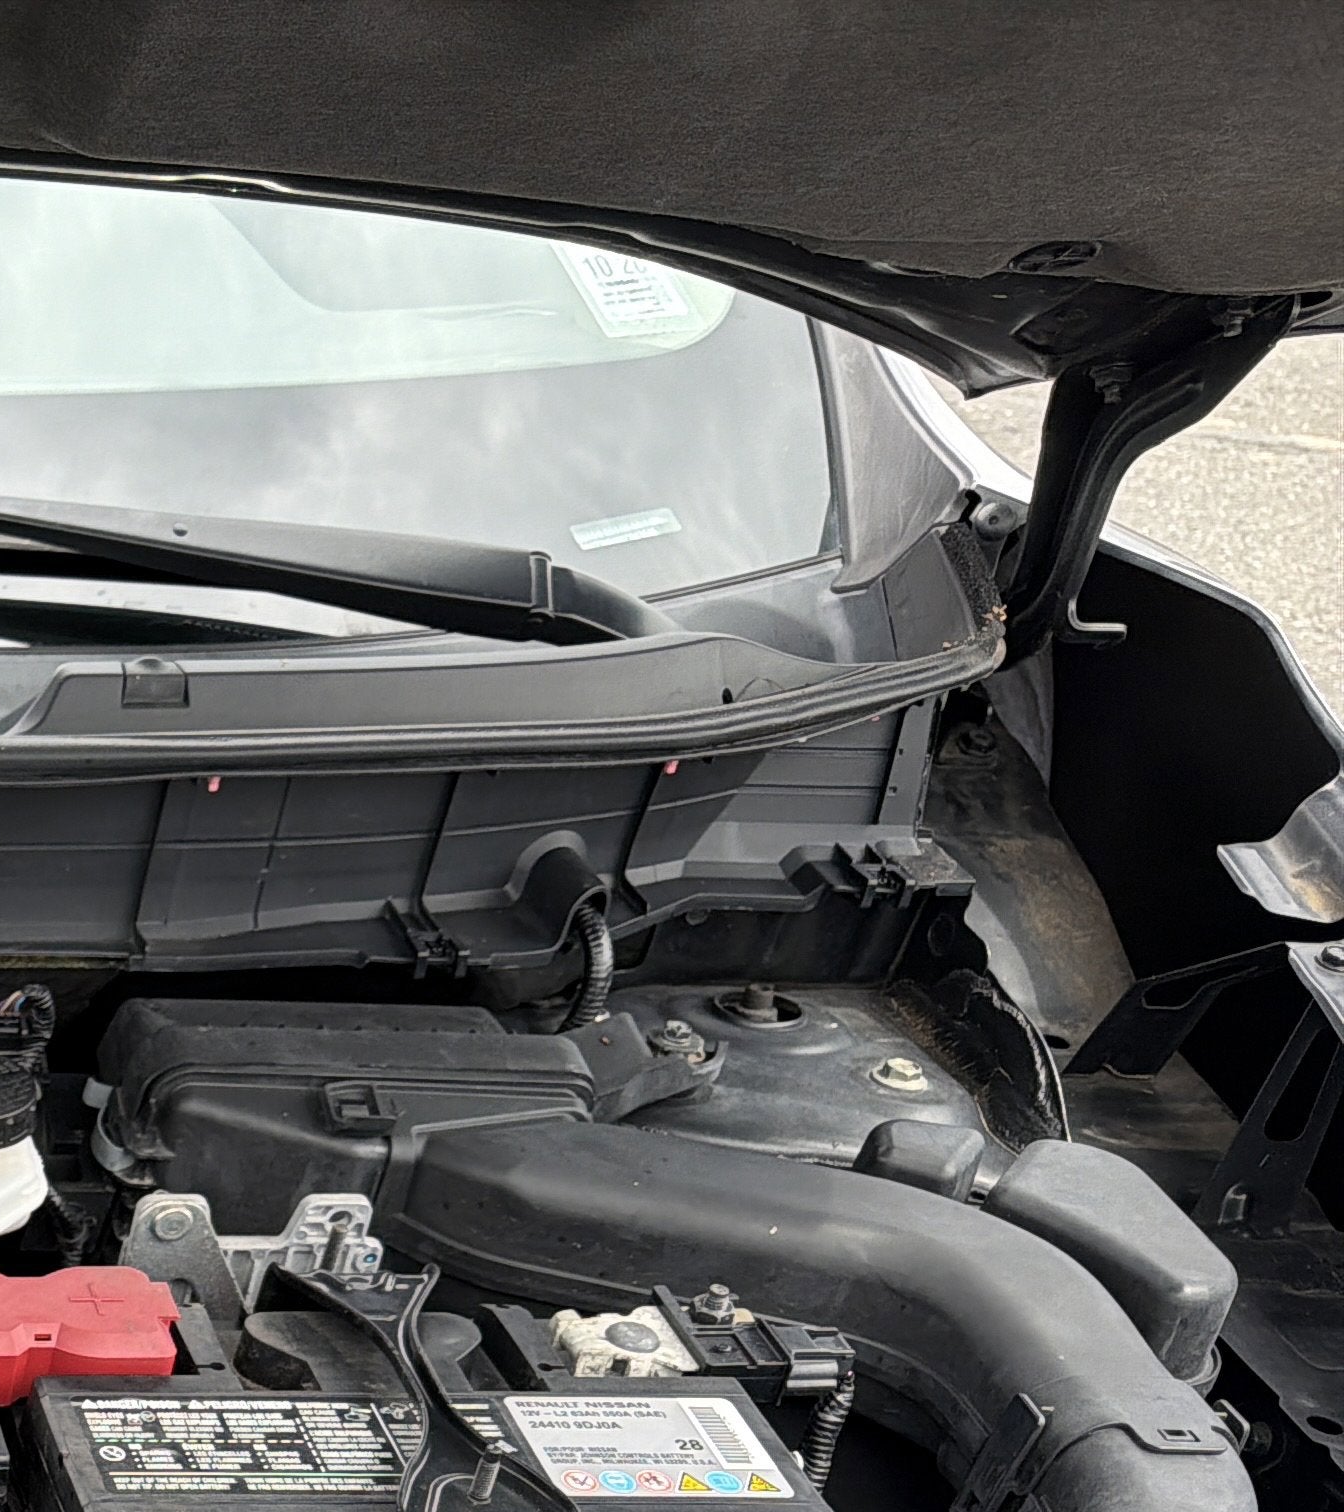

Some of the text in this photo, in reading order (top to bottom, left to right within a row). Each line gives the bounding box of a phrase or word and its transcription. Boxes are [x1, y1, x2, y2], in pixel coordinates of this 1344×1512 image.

[515, 1401, 651, 1409] RENAULT NISSAN
[633, 1410, 667, 1419] (SAE)
[528, 1420, 571, 1429] 24410
[675, 1439, 704, 1451] 28
